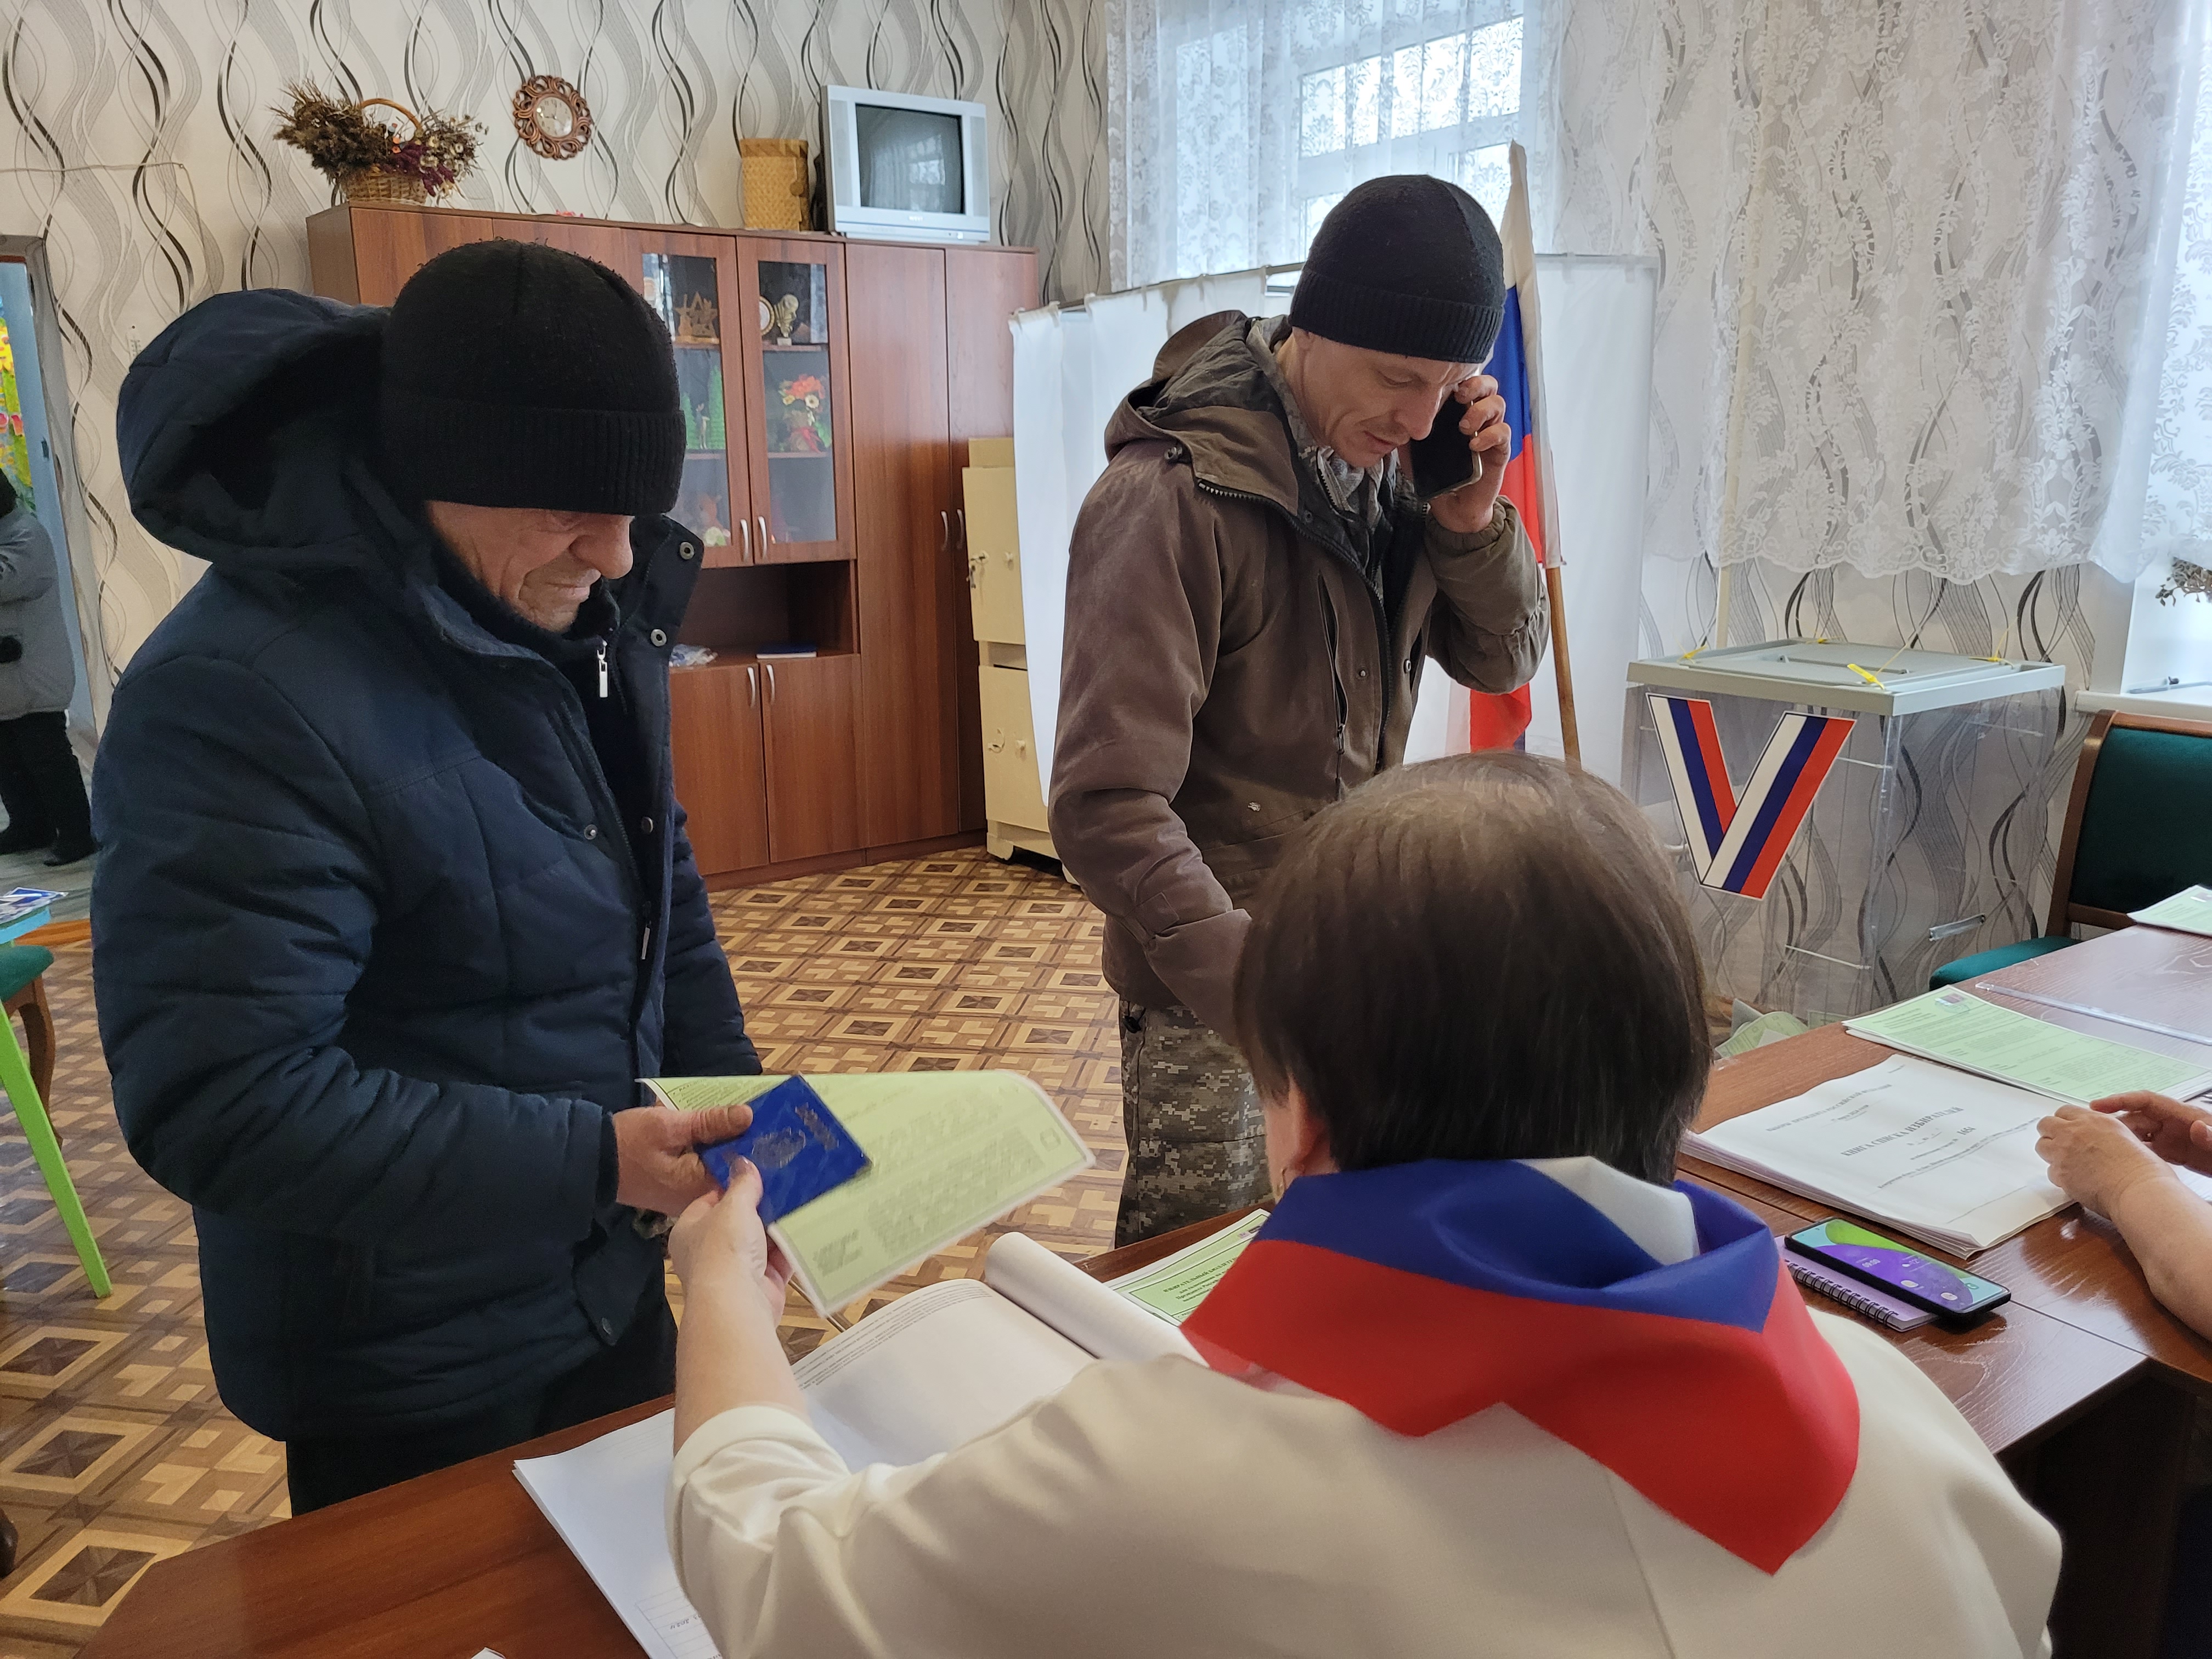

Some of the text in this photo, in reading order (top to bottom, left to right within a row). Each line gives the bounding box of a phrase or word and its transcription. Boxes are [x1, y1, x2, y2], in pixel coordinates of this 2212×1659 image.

[1841, 1142, 1875, 1156] КНИГА
[1872, 1130, 1910, 1146] СПИСКА
[1904, 1106, 1964, 1132] ИЗБИРАТЕЛЕЙ
